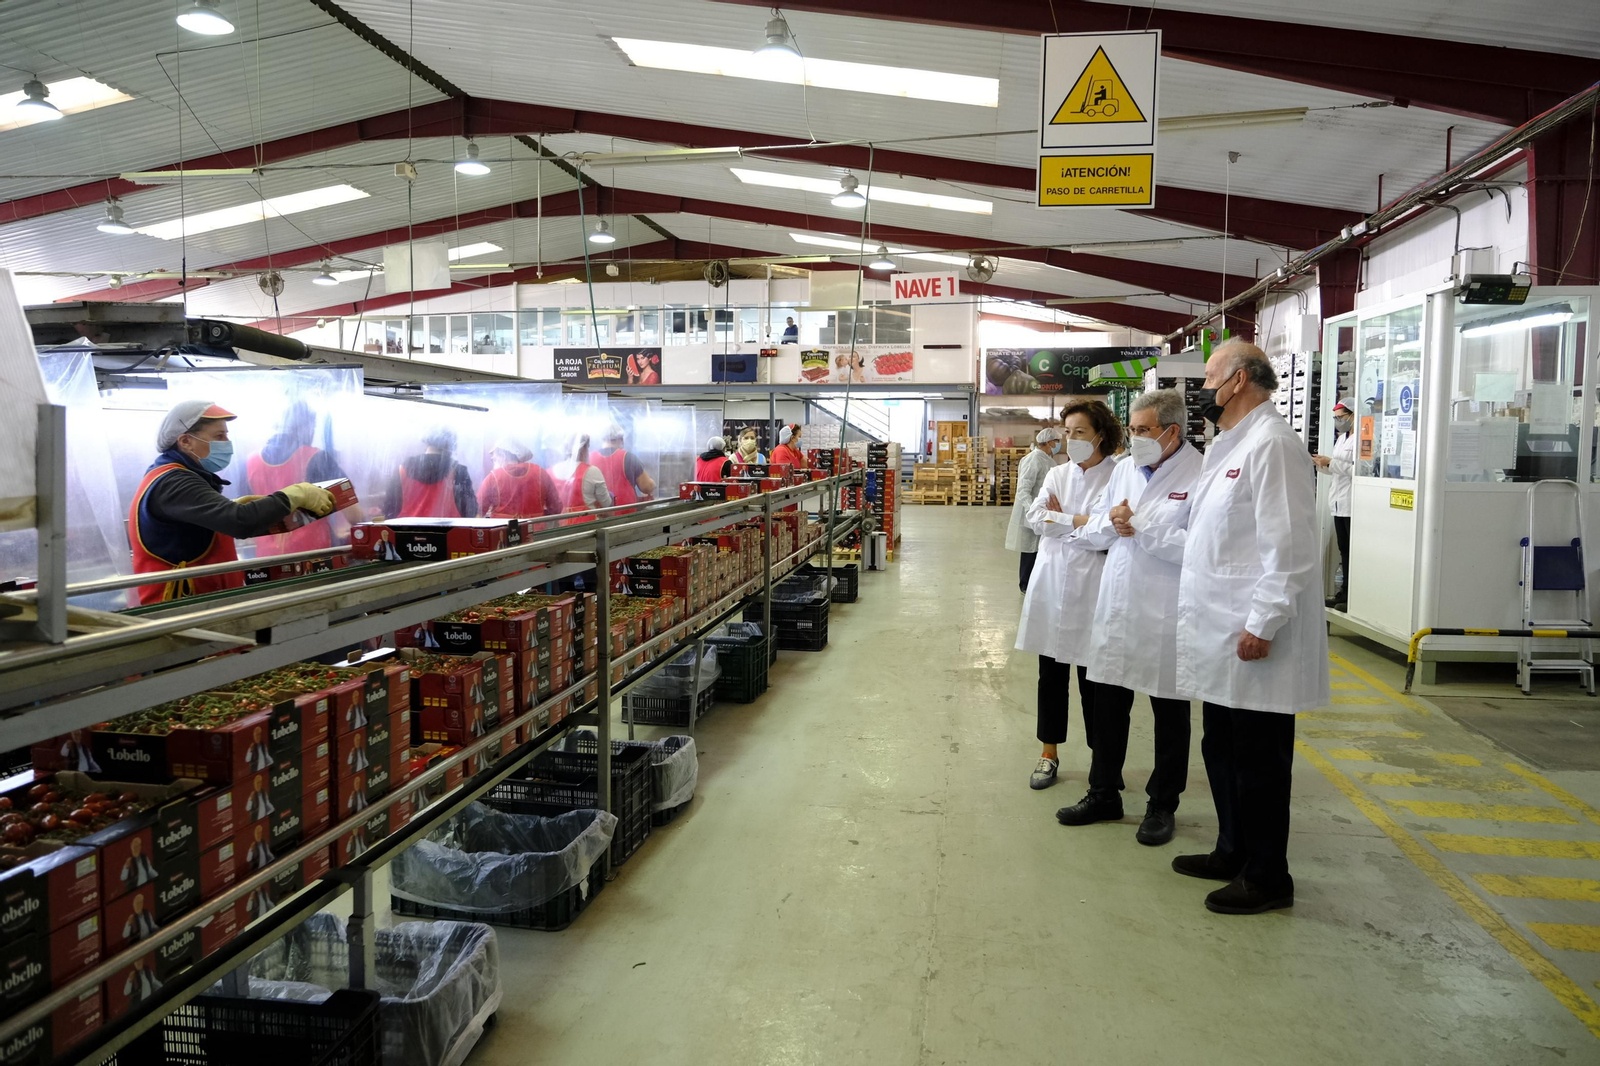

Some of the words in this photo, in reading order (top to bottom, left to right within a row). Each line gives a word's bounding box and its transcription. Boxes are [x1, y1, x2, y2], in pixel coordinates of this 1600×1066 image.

[1061, 164, 1131, 178] ¡ATENCIÓN!
[1046, 187, 1070, 195] PASO
[1073, 187, 1086, 195] DE
[1089, 186, 1144, 195] CARRETILLA
[895, 277, 941, 299] NAVE
[947, 276, 954, 296] 1
[1061, 353, 1090, 363] Grupo
[406, 543, 437, 552] Lobello
[444, 631, 472, 641] Lobello
[107, 748, 151, 762] Lobello
[157, 825, 193, 849] Lobello
[160, 877, 195, 903] Lobello
[0, 896, 40, 926] obello
[161, 930, 195, 958] Lobello
